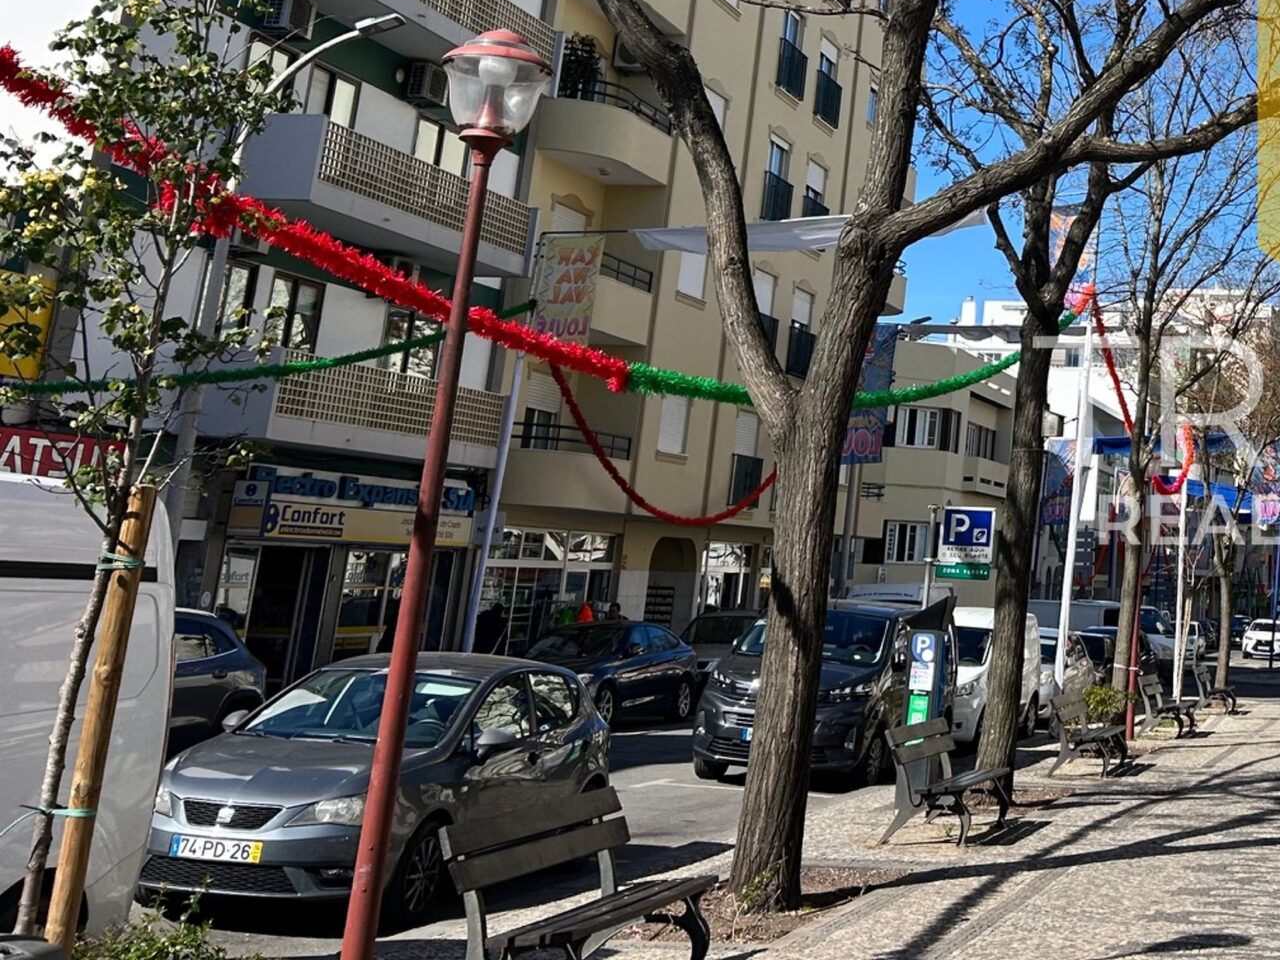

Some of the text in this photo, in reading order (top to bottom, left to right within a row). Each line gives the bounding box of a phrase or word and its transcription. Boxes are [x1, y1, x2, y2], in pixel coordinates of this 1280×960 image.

[338, 476, 421, 507] Expans
[281, 505, 345, 525] Confort
[949, 514, 970, 541] P
[916, 635, 930, 654] P
